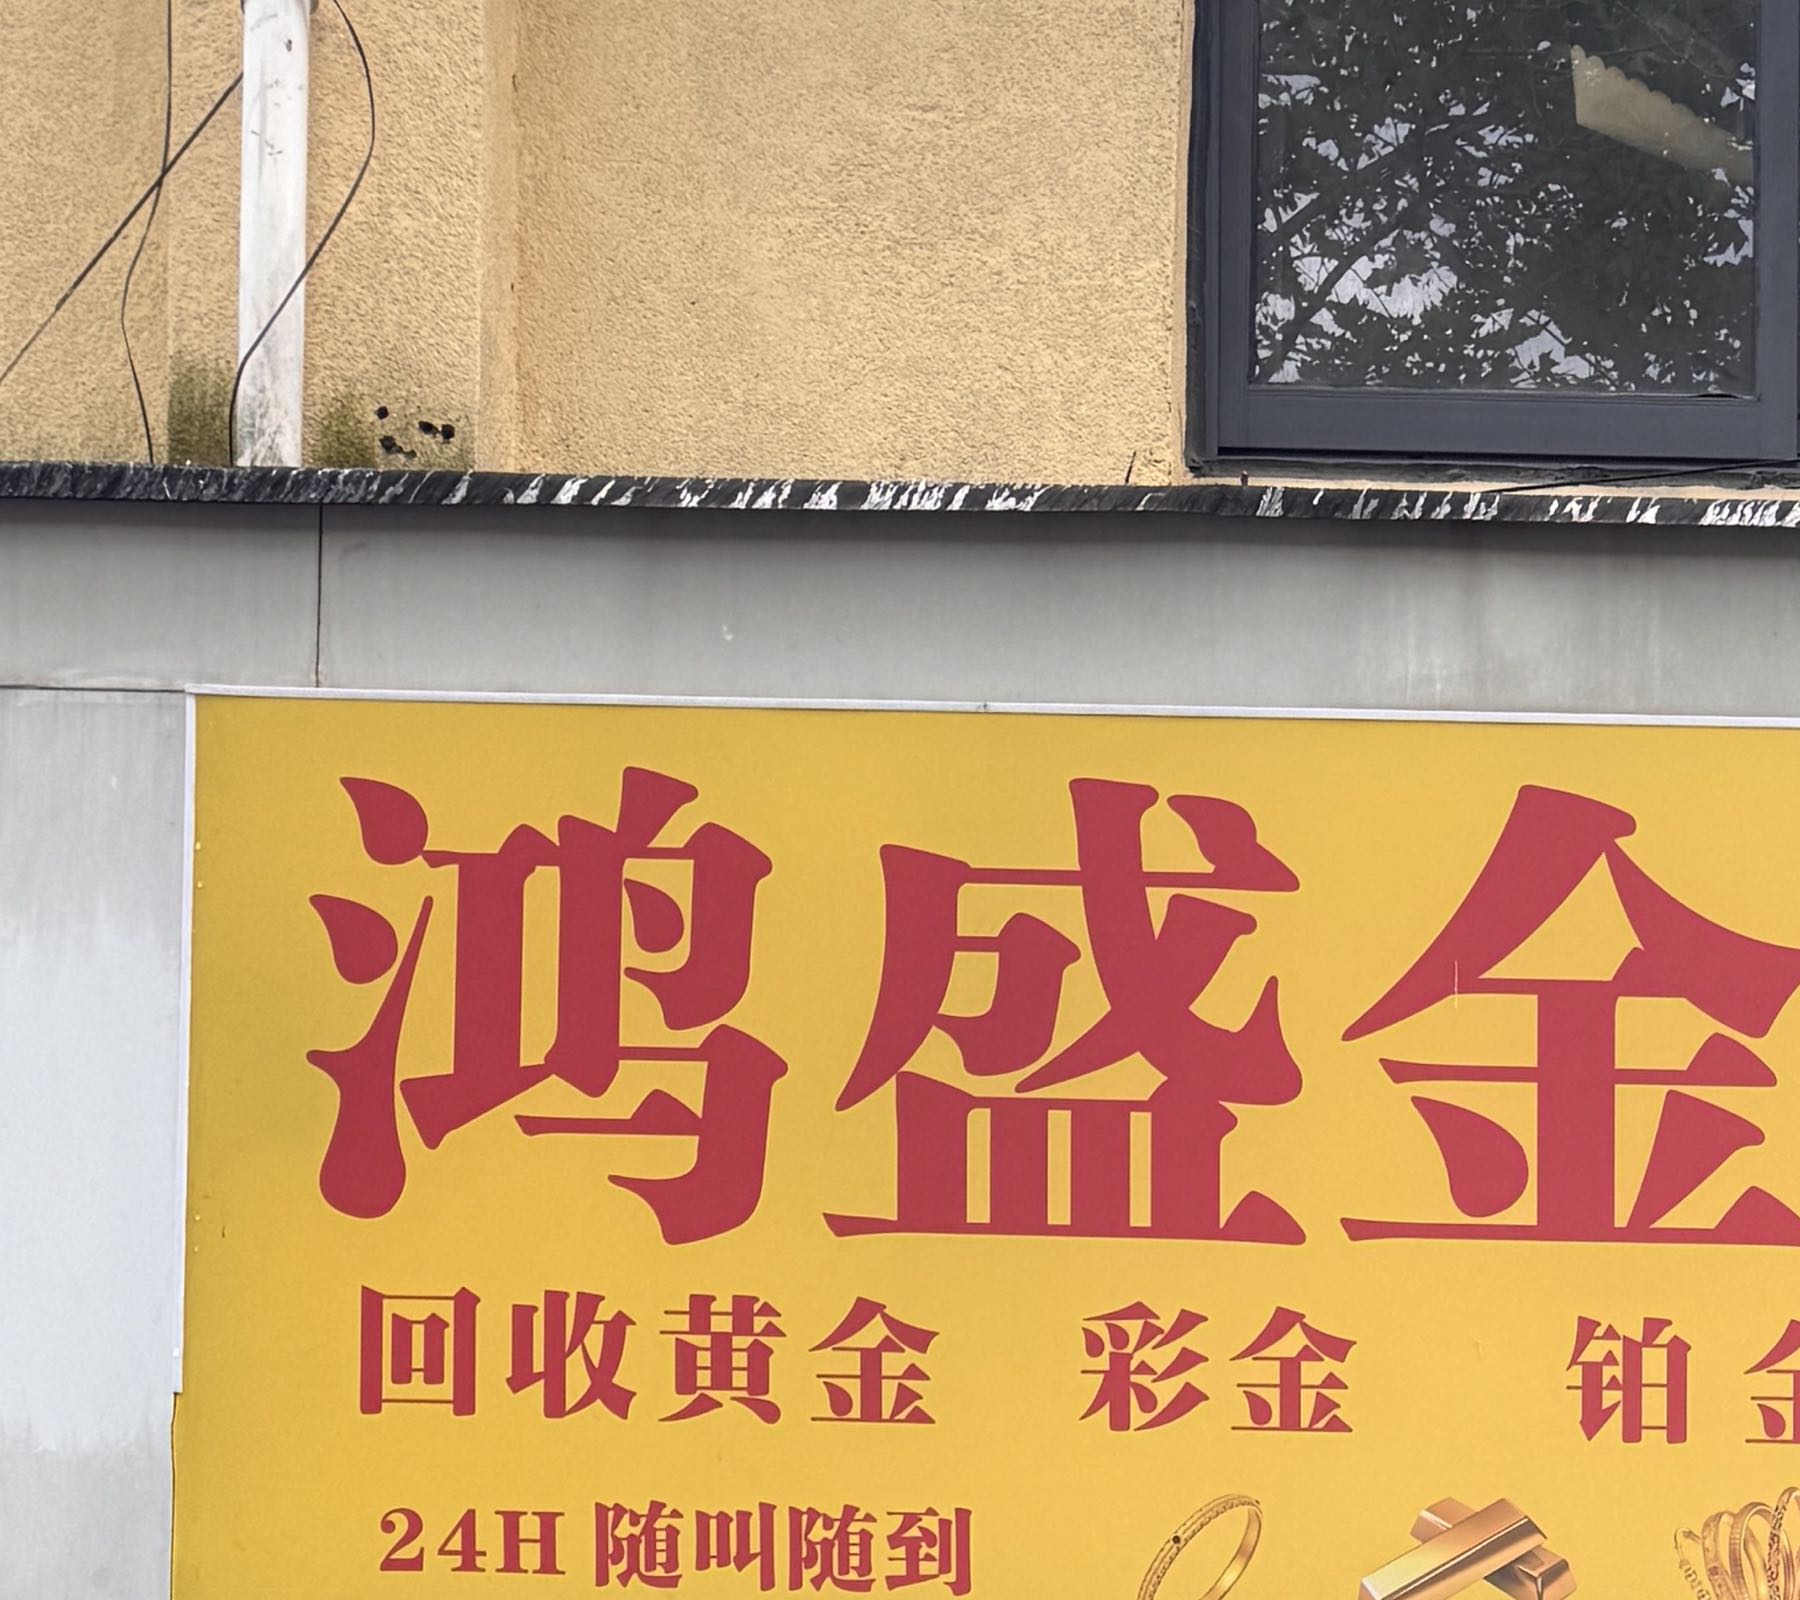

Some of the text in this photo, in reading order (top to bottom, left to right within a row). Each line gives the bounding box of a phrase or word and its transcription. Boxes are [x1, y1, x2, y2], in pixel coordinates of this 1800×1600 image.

[358, 1286, 937, 1425] 回收黄金
[1078, 1300, 1358, 1434] 彩金
